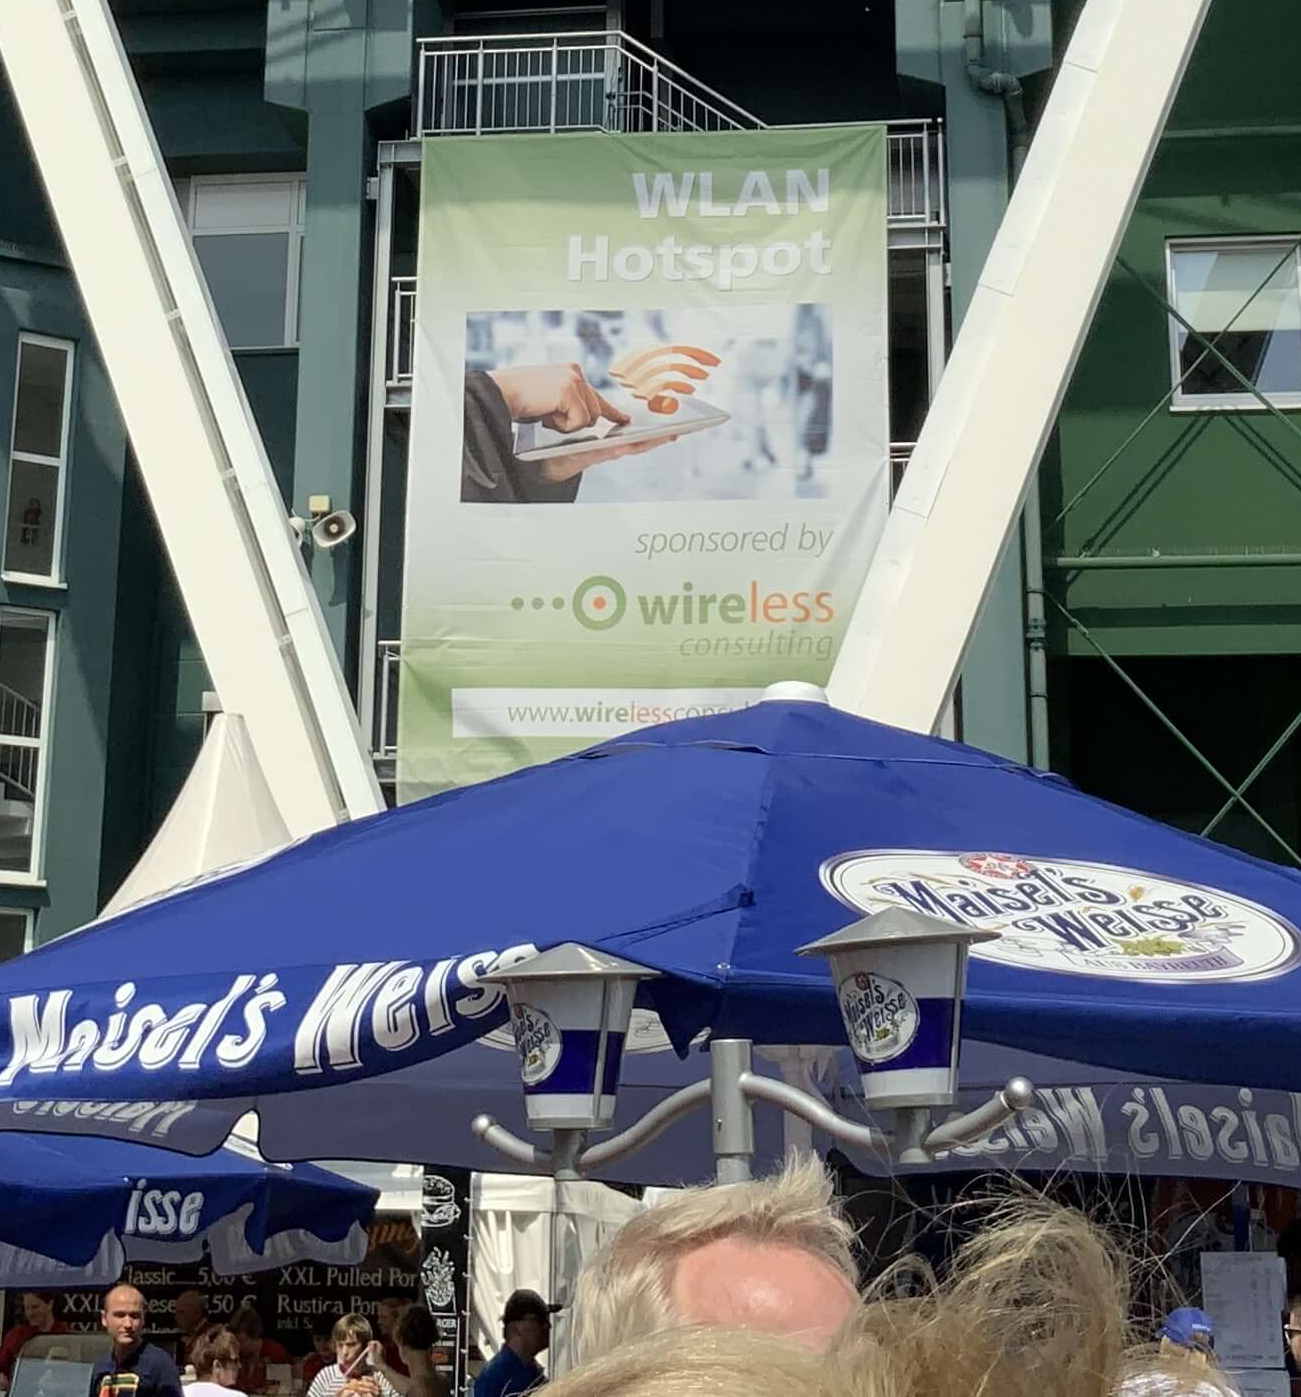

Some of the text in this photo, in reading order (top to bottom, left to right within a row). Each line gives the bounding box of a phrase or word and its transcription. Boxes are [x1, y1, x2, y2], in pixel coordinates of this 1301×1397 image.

[632, 168, 831, 219] WLAN
[567, 229, 833, 291] Hotspot
[635, 523, 834, 558] sponsored by
[638, 580, 835, 625] wireless
[679, 628, 834, 660] consulting
[873, 867, 1128, 925] Maisel's
[1011, 893, 1230, 953] Weisse
[125, 1180, 203, 1236] isse
[125, 1265, 176, 1285] lassic
[278, 1265, 419, 1288] XXL Pulled Por
[276, 1293, 345, 1315] Rustica
